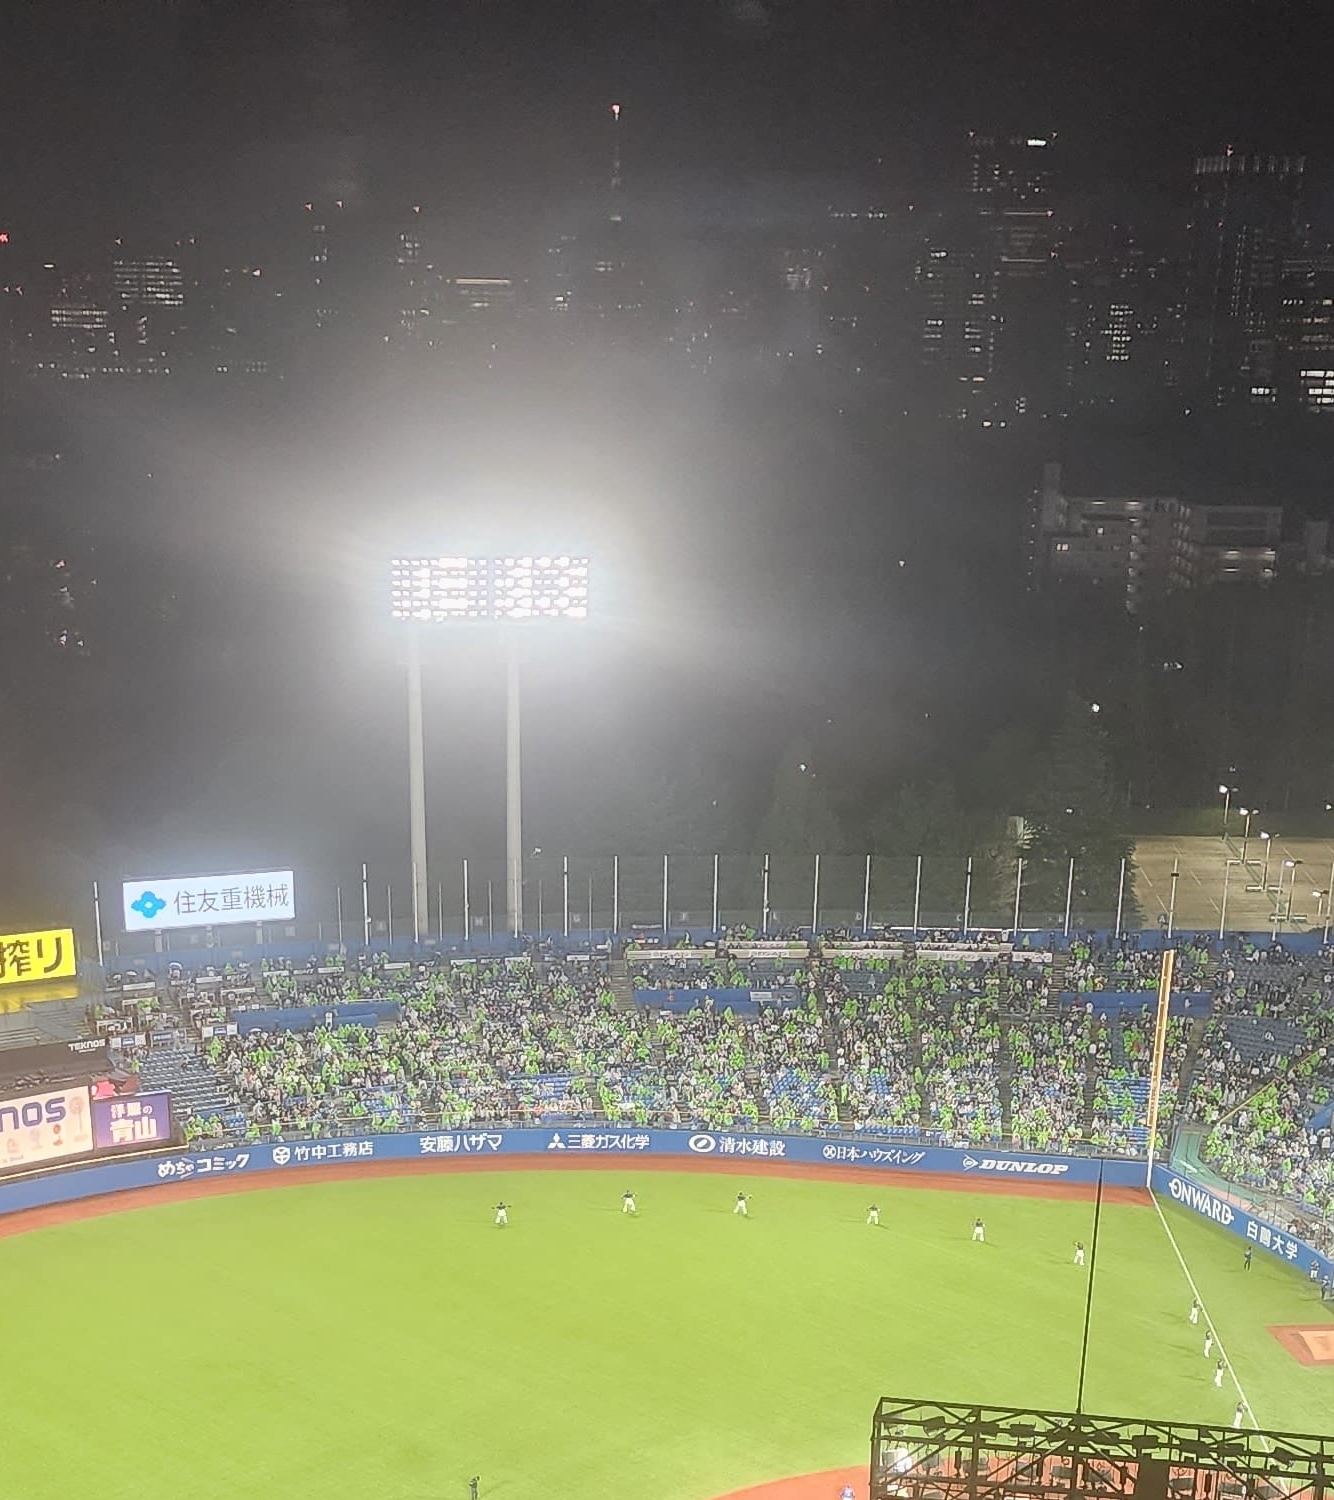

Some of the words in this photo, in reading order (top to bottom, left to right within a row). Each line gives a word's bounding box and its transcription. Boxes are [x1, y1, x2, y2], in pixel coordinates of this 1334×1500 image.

[173, 884, 289, 916] 住友重機械
[68, 1038, 106, 1052] TEKNOS
[110, 1116, 158, 1143] 青山
[293, 1141, 374, 1161] 竹中工務店
[419, 1133, 503, 1153] 安藤ハザマ
[567, 1134, 650, 1150] 三菱ガス化学
[719, 1136, 786, 1157] 清水建設
[836, 1145, 926, 1165] 日本ハウズイング
[157, 1153, 250, 1179] めちゃコミック
[978, 1158, 1069, 1175] DUNLOP
[1168, 1178, 1234, 1226] ONWARD
